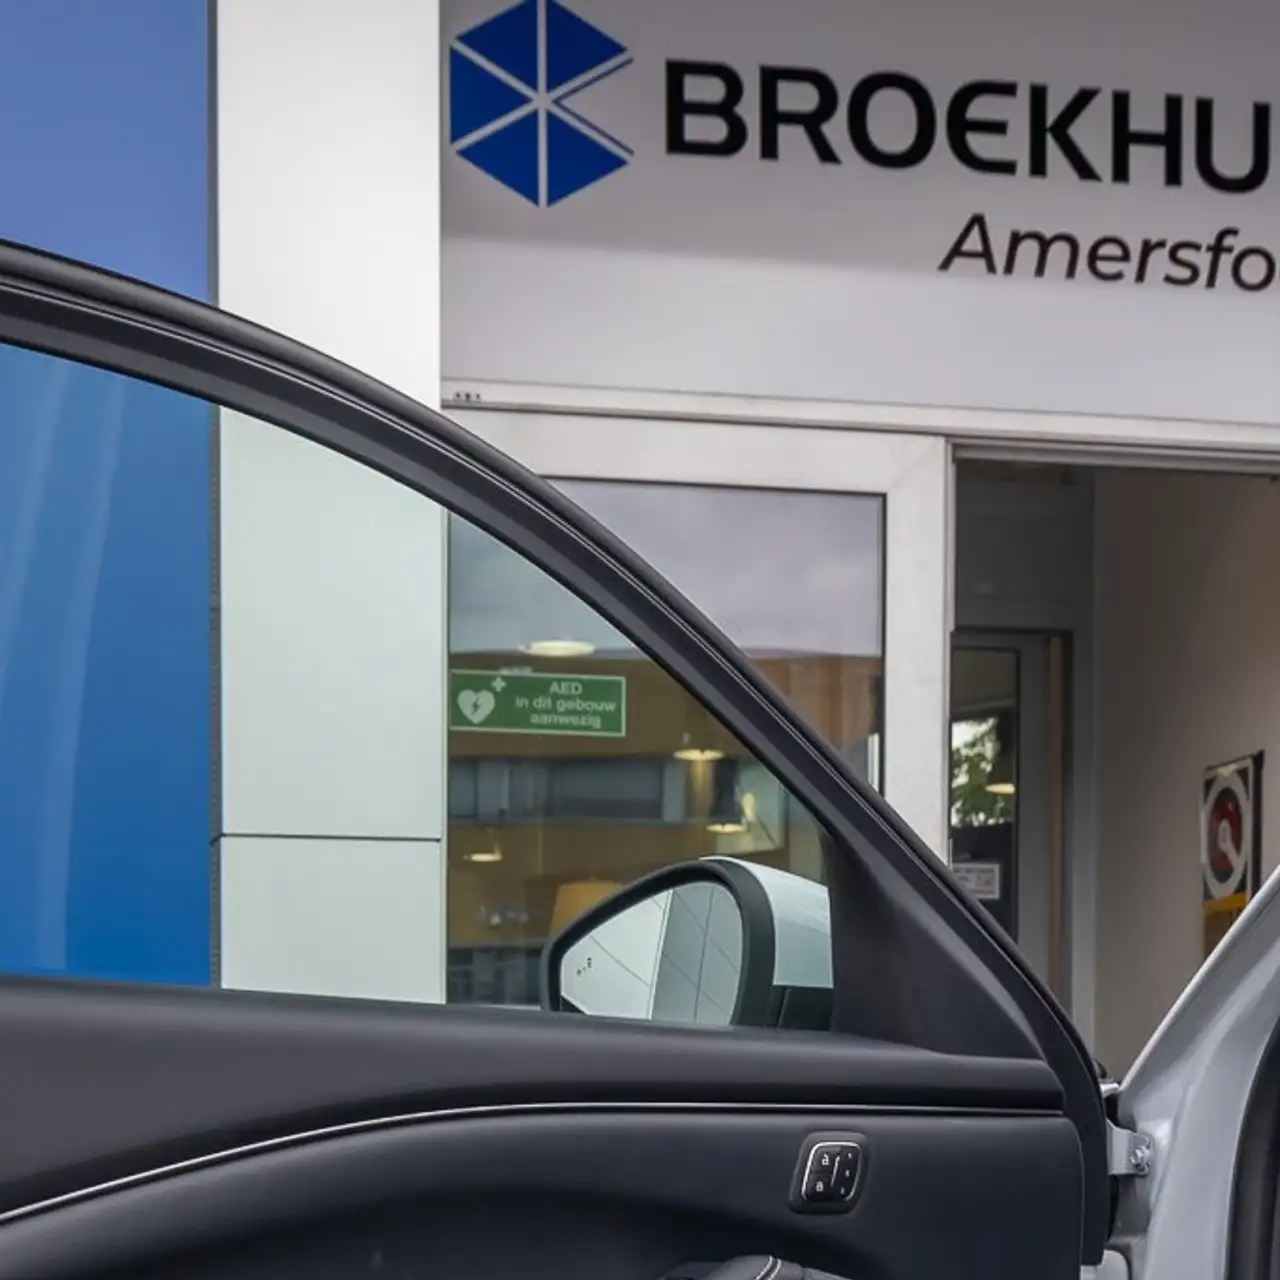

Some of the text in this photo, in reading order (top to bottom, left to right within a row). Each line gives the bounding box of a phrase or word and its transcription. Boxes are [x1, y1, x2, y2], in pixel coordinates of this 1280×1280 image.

[550, 682, 582, 695] AED
[533, 696, 552, 709] dit
[557, 698, 616, 712] gebouw
[530, 713, 601, 729] aanwezig
